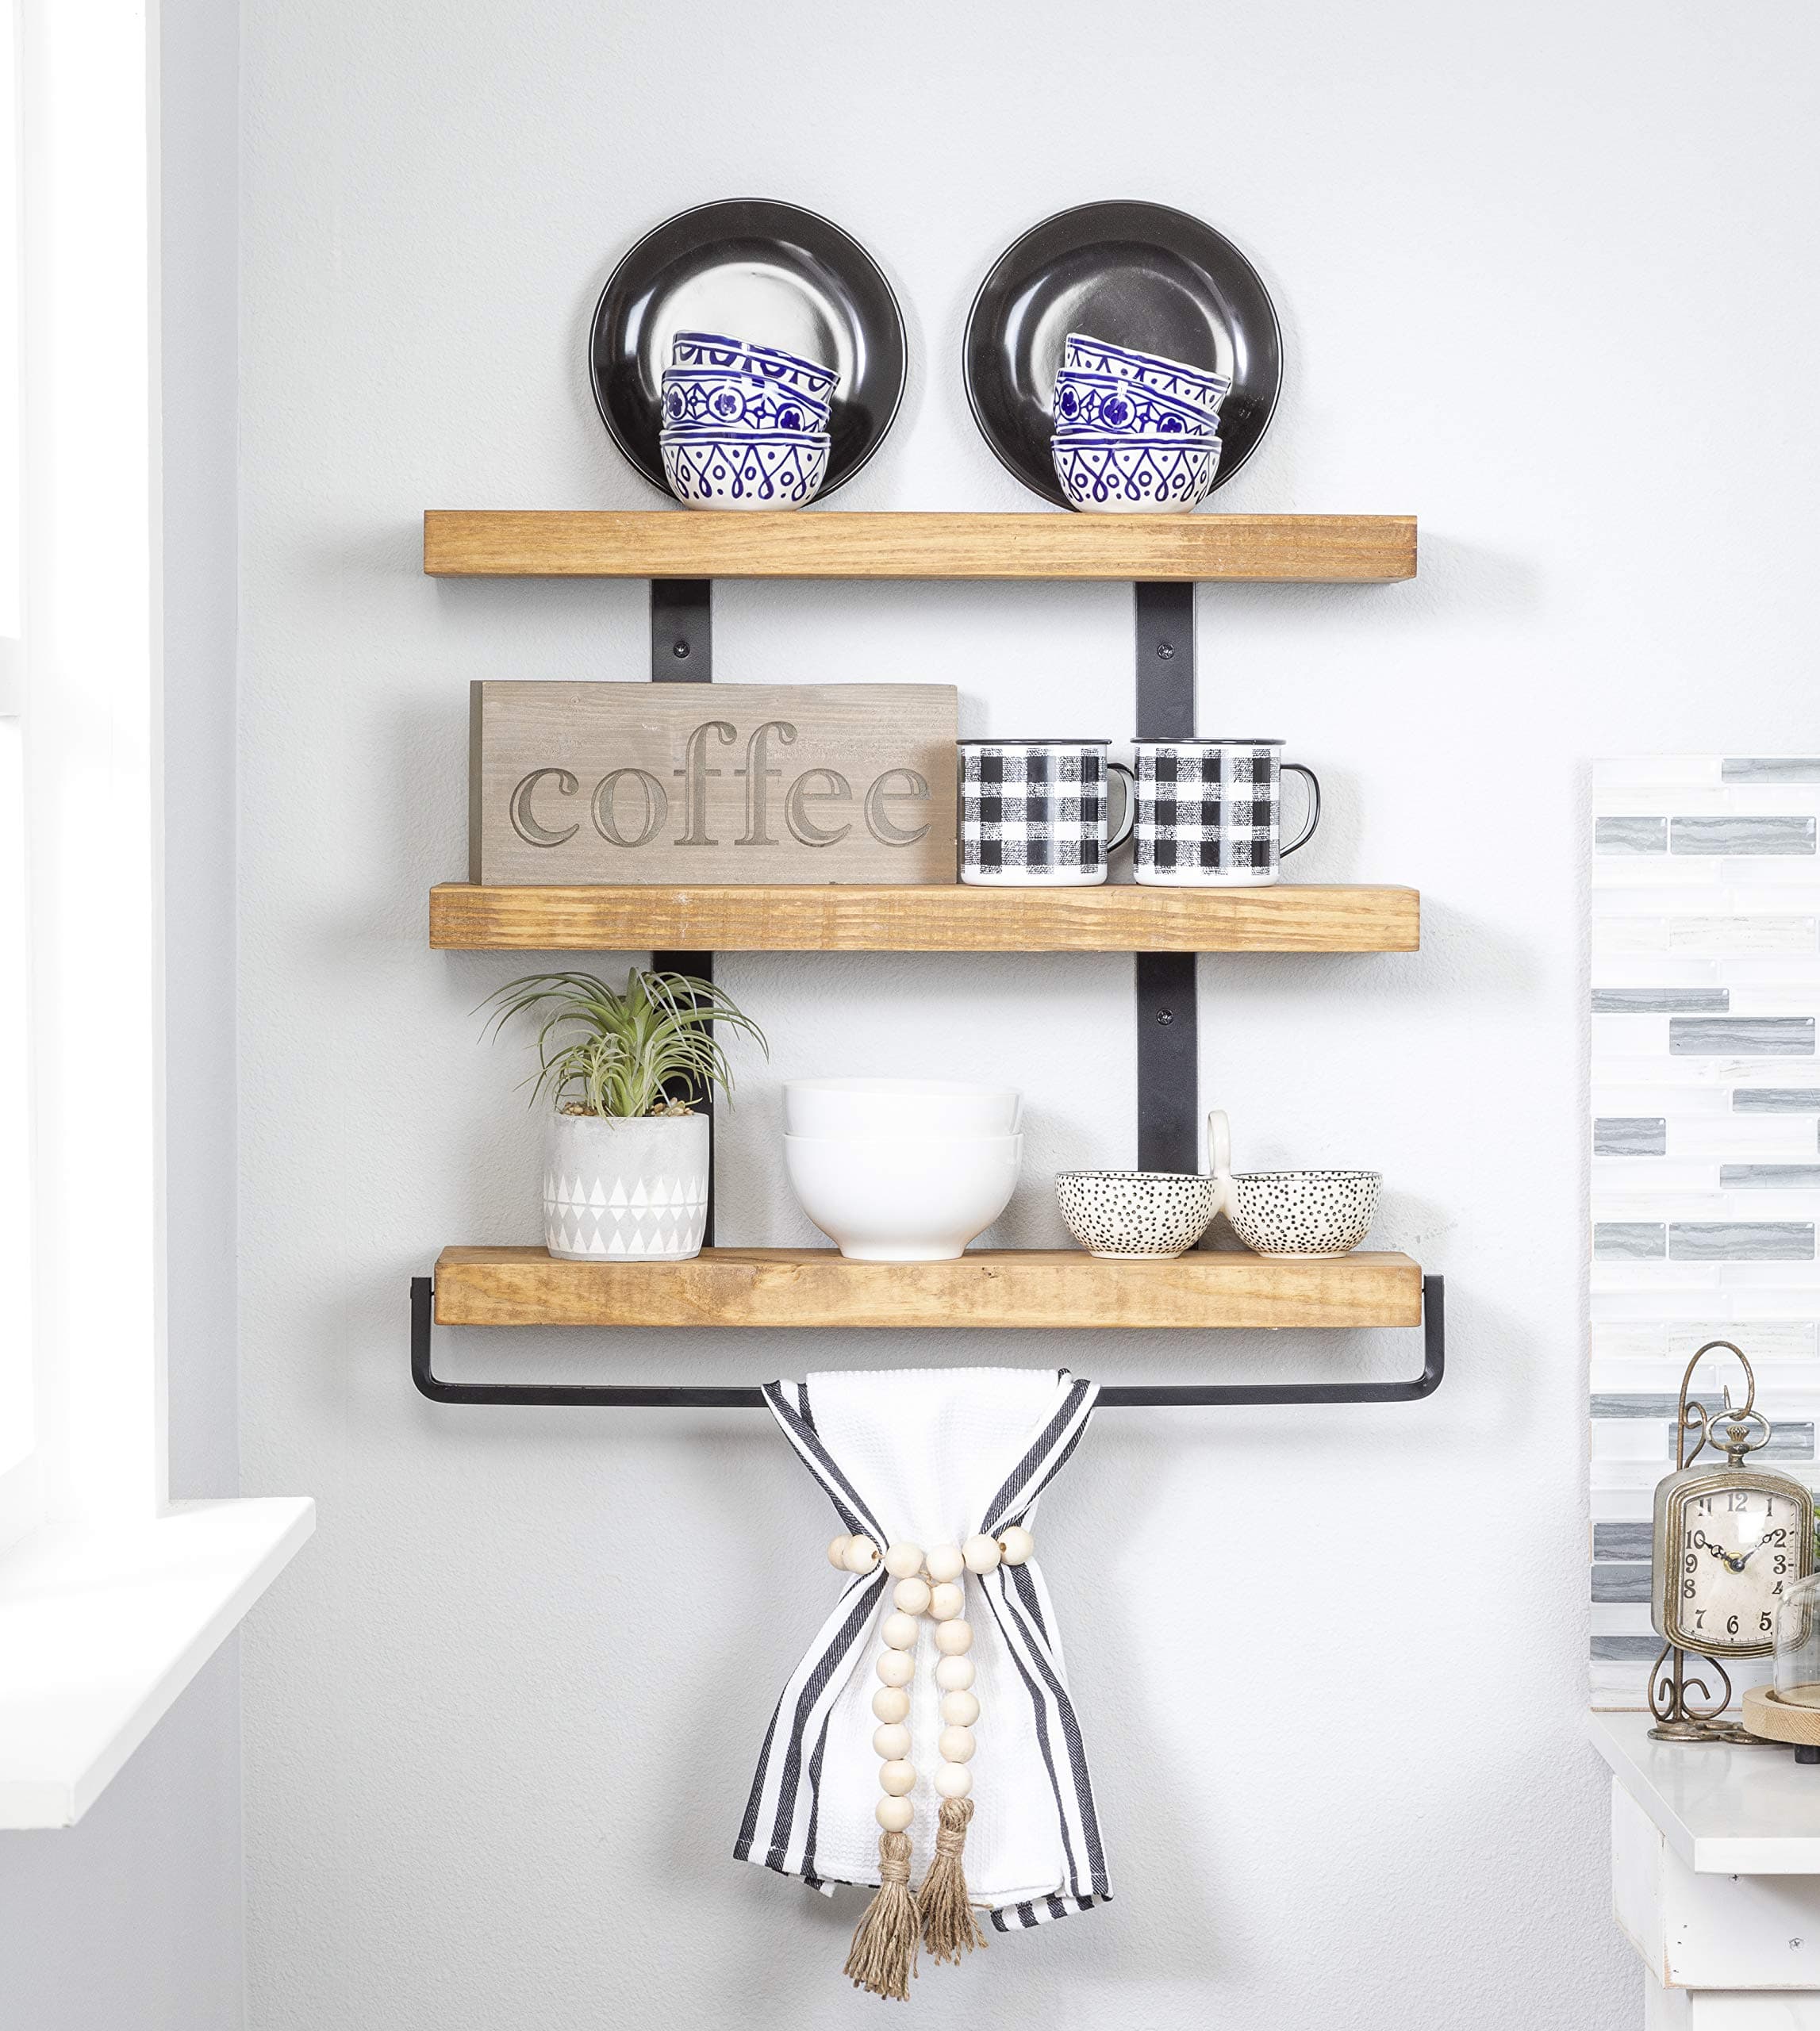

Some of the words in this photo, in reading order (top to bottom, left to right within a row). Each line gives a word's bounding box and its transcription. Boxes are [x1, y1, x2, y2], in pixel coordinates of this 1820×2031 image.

[509, 720, 932, 847] coffee
[1727, 1492, 1749, 1512] 12
[1765, 1497, 1773, 1517] 1
[1686, 1530, 1706, 1549] 10
[1774, 1528, 1787, 1548] 2
[1685, 1553, 1698, 1573] 9
[1773, 1554, 1787, 1574] 3
[1684, 1579, 1696, 1599] 8
[1695, 1609, 1707, 1629] 7
[1726, 1614, 1739, 1635] 6
[1759, 1611, 1772, 1631] 5
